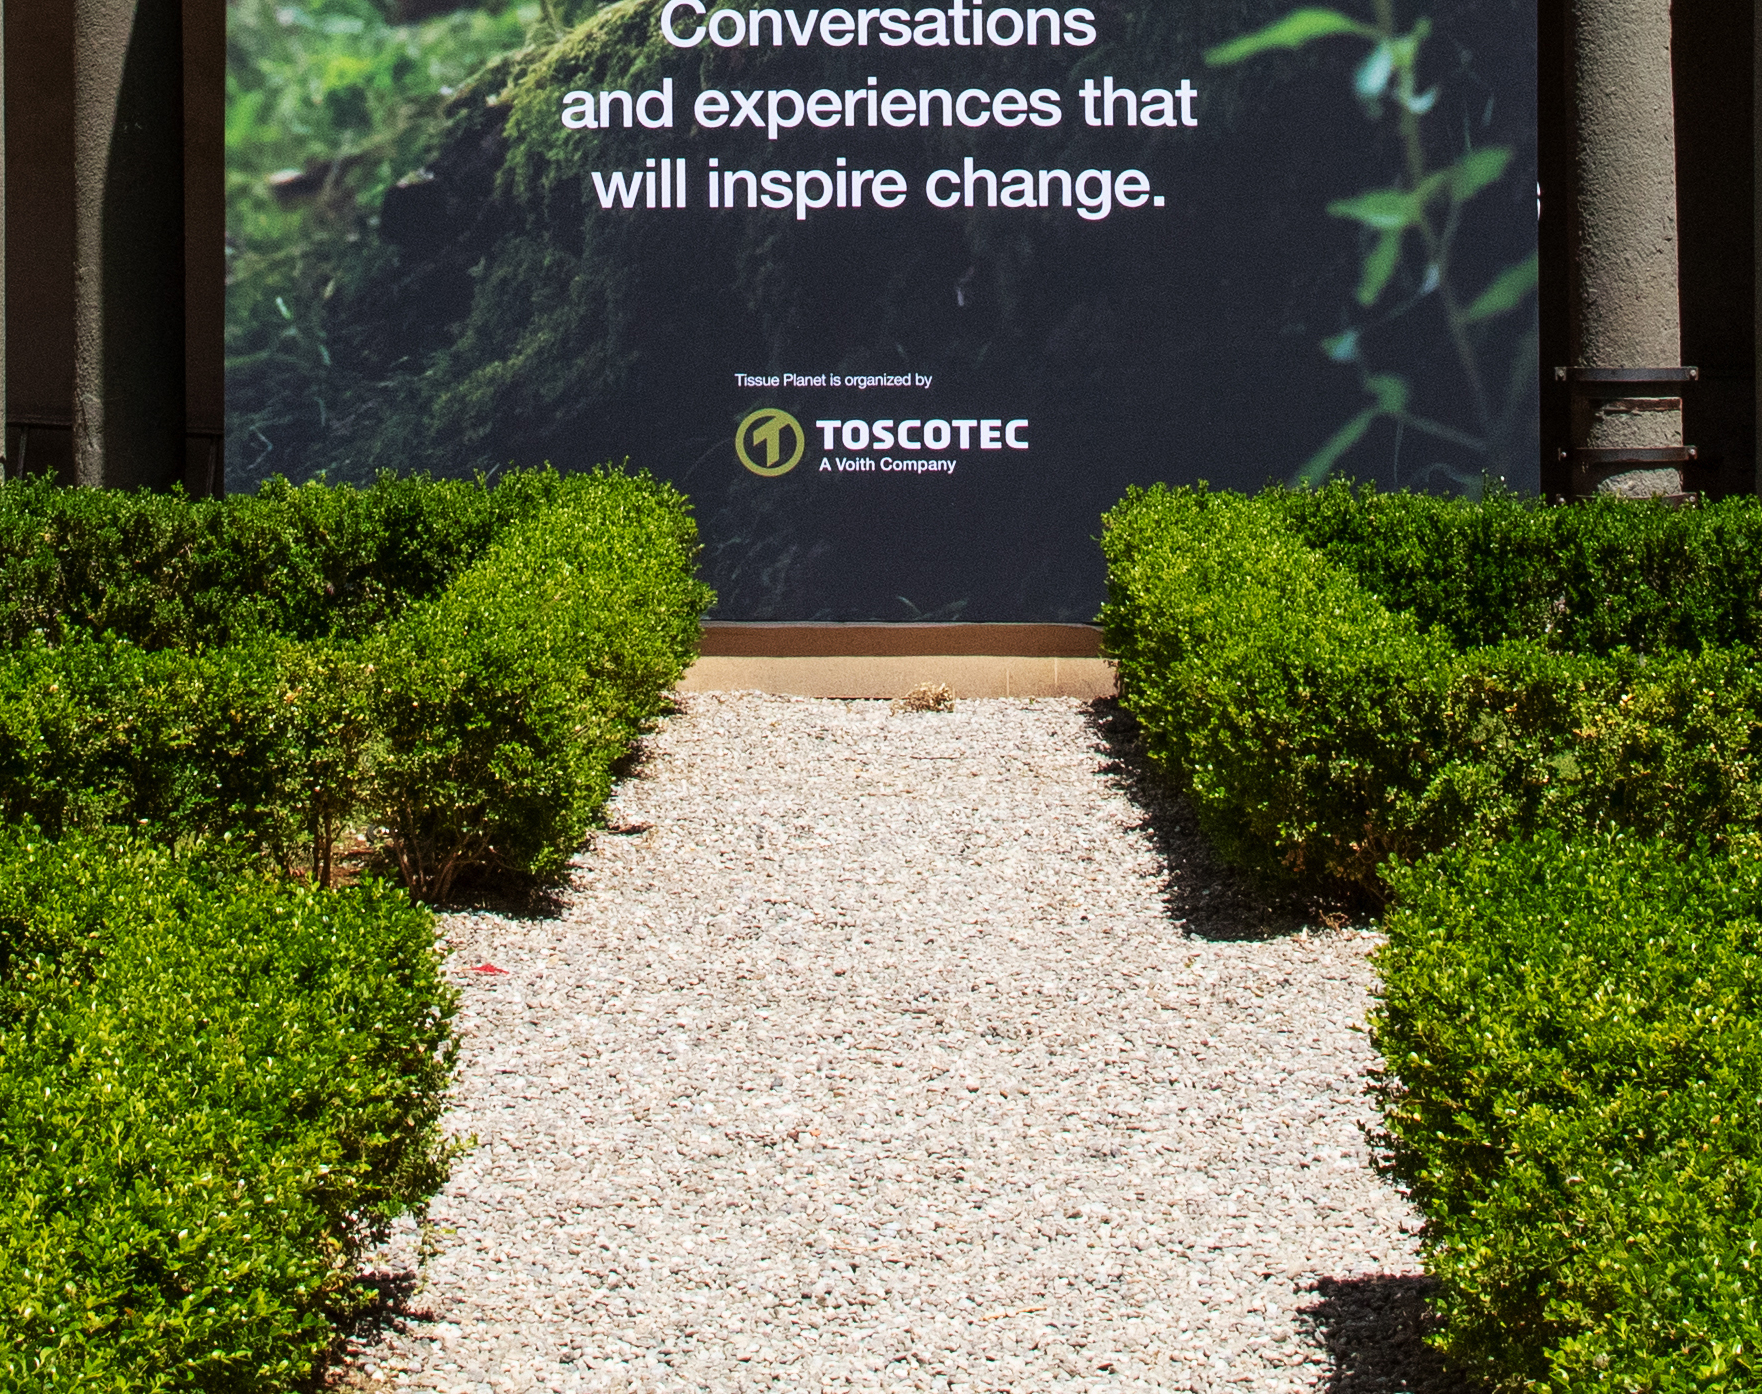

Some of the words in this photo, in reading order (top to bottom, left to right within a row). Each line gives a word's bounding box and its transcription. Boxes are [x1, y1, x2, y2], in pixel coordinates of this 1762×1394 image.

[561, 78, 673, 129] and
[693, 76, 1062, 140] experiences
[1079, 77, 1198, 128] that
[592, 157, 687, 210] will
[708, 157, 907, 220] inspire
[925, 156, 1166, 221] change.
[734, 373, 780, 387] Tissue
[783, 373, 827, 387] Planet
[829, 373, 842, 387] is
[844, 373, 912, 389] organized
[915, 373, 933, 389] by
[815, 419, 1030, 451] TOSCOTEC
[819, 457, 832, 471] A
[835, 457, 876, 472] Voith
[880, 457, 957, 474] Company
